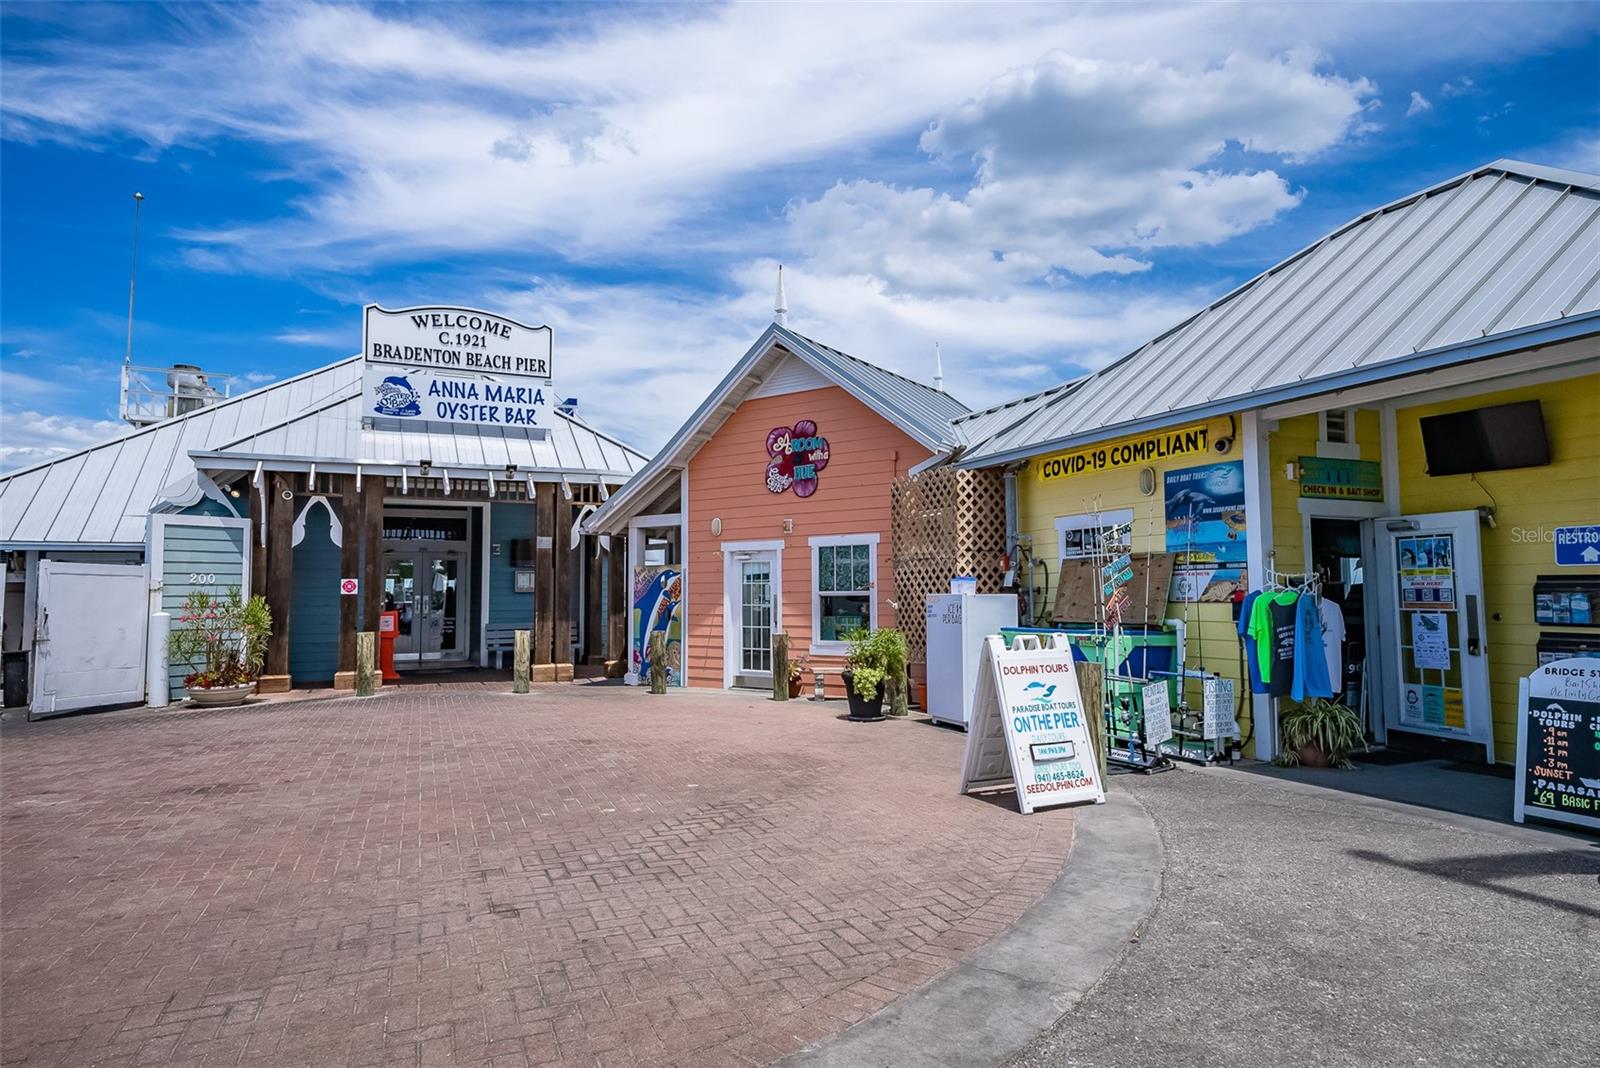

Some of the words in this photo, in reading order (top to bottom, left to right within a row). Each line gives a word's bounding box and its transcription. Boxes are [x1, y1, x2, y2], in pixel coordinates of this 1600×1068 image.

[411, 314, 512, 339] WELCOME
[439, 332, 487, 347] C.1921
[373, 343, 461, 365] BRADENTON
[466, 352, 511, 370] BEACH
[516, 357, 547, 373] PIER
[428, 380, 479, 400] ANNA
[485, 385, 545, 405] MARIA
[437, 401, 500, 422] OYSTER
[505, 408, 537, 425] BAR
[791, 437, 824, 452] ROOM
[1043, 450, 1106, 478] COVID-19
[1110, 429, 1208, 466] COMPLIANT
[794, 464, 816, 480] HUE
[1180, 473, 1192, 482] BOAT
[1192, 471, 1208, 481] TOURS
[1302, 485, 1327, 494] CHECK
[1327, 486, 1337, 495] IN
[1346, 487, 1361, 496] BAIT
[1363, 488, 1381, 497] SHOP
[1558, 531, 1600, 545] RESTRO
[189, 573, 216, 584] 200
[1003, 665, 1039, 676] DOLPHIN
[1040, 663, 1069, 673] TOURS
[1544, 667, 1585, 677] BRIDGE
[1205, 679, 1233, 693] FISHING
[1012, 703, 1041, 714] PARADISE
[1041, 702, 1057, 711] BOAT
[1057, 701, 1076, 710] TOURS
[1014, 716, 1032, 733] ON
[1030, 713, 1054, 731] THE
[1055, 711, 1080, 729] PIER
[1533, 709, 1582, 722] DOLPHIN
[1539, 718, 1576, 729] TOURS
[1549, 727, 1555, 737] 9
[1547, 736, 1556, 746] 11
[1549, 746, 1555, 756] 1
[1548, 758, 1555, 767] 3
[1034, 772, 1051, 784] (941)
[1052, 769, 1085, 782] 465-8624
[1533, 766, 1574, 780] SUNSET
[1026, 777, 1094, 794] SEEDOLPHIN.COM
[1562, 794, 1591, 809] BASIC
